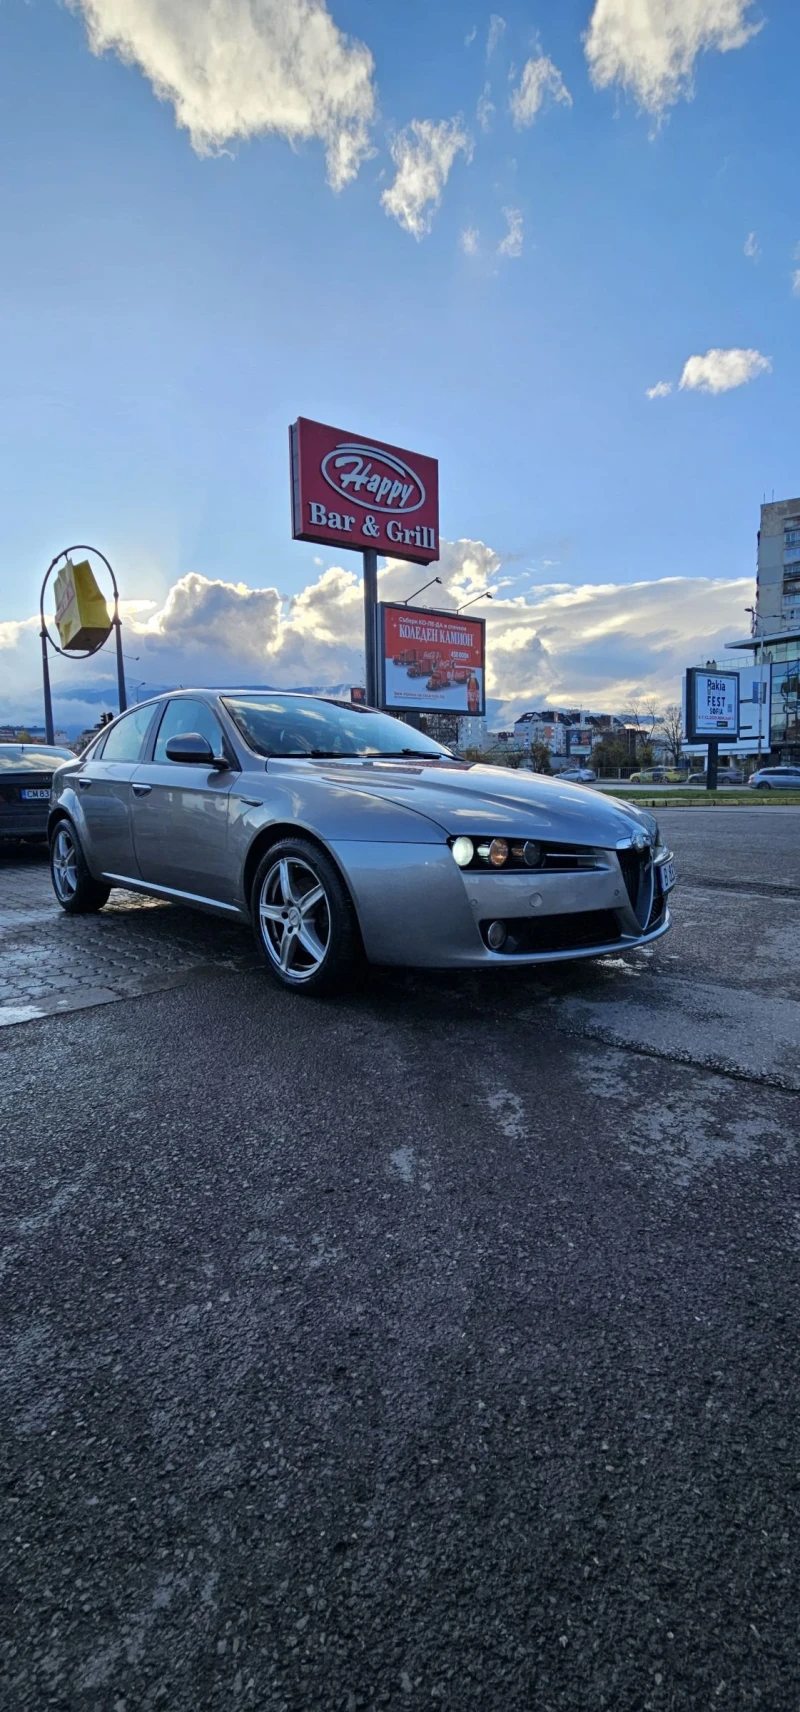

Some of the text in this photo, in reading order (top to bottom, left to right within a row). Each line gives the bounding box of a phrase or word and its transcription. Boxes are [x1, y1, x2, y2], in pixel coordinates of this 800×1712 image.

[335, 455, 415, 508] Happy
[309, 501, 436, 550] Bar & Grill
[400, 624, 473, 646] КОЛЕДЕН КАМИОН
[707, 679, 726, 691] Rakia
[707, 695, 726, 707] FEST
[40, 790, 49, 798] 83
